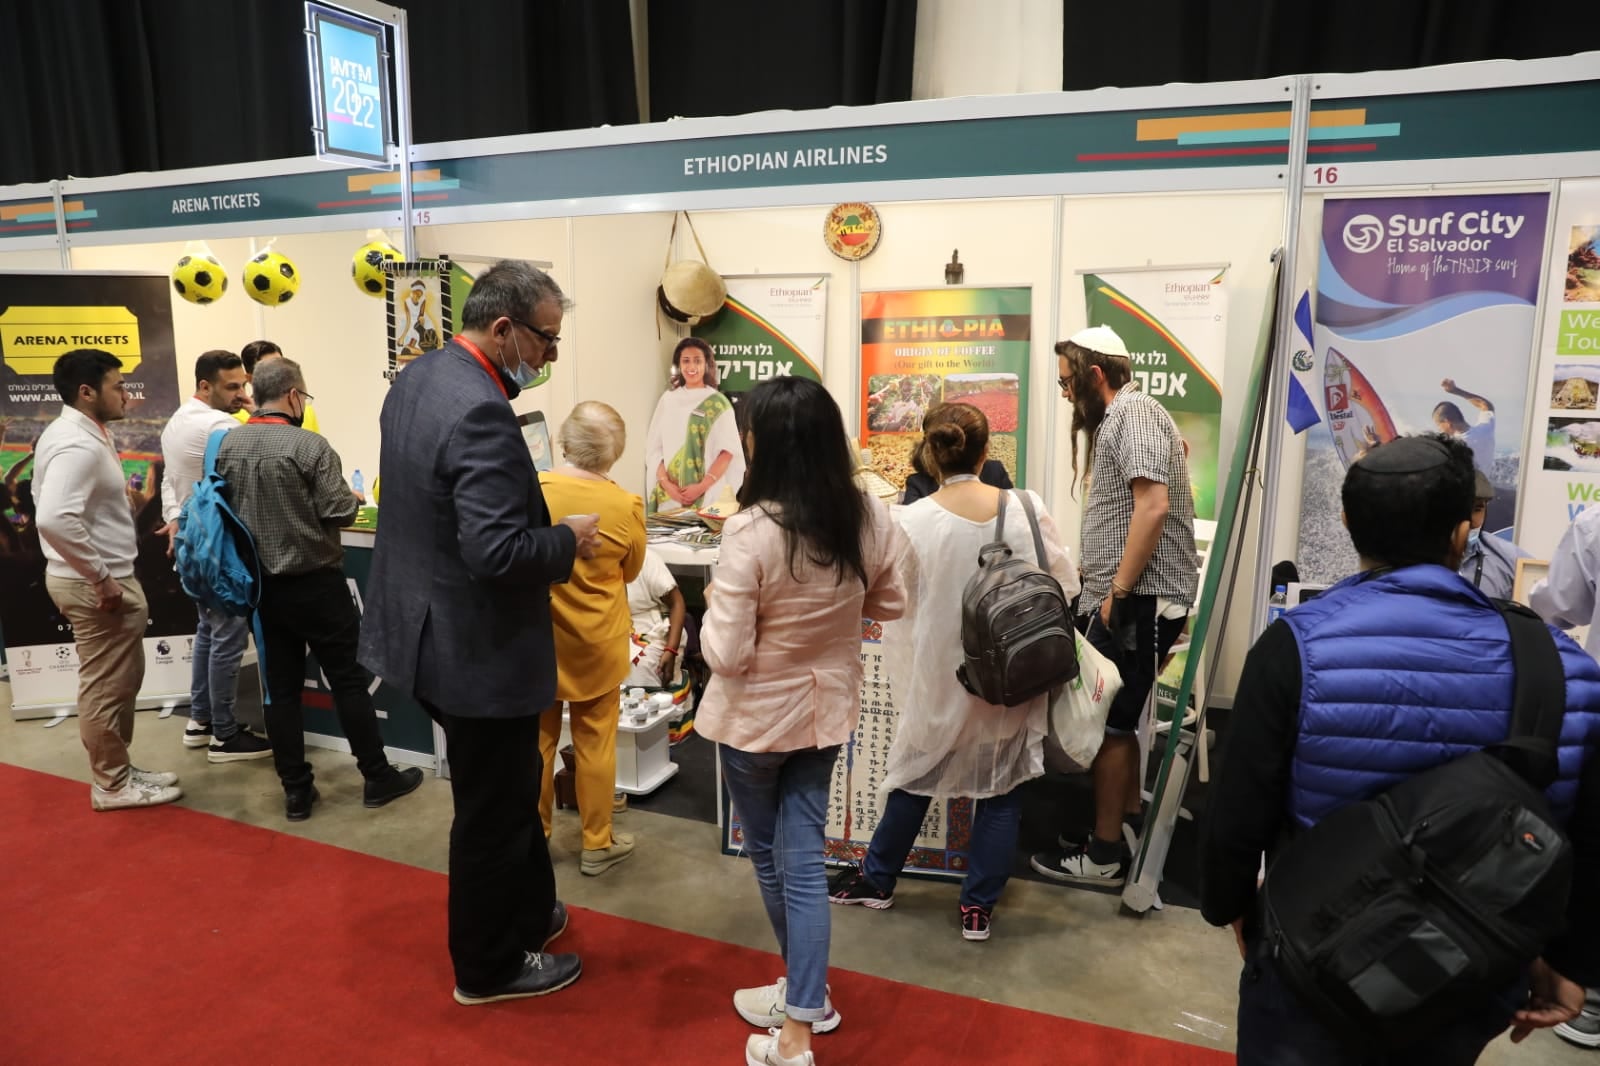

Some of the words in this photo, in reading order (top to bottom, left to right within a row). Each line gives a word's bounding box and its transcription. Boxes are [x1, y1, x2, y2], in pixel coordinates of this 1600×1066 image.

[684, 150, 788, 175] ETHIOPIAN
[793, 144, 888, 168] AIRLINES
[1313, 166, 1338, 185] 16
[171, 197, 210, 214] ARENA
[211, 192, 261, 211] TICKETS
[416, 211, 431, 224] 15
[1388, 211, 1455, 237] Surf
[1458, 209, 1525, 239] City
[1386, 237, 1405, 253] El
[1407, 236, 1492, 253] Salvador
[1387, 256, 1418, 275] Home
[1420, 261, 1430, 281] of
[1567, 313, 1600, 329] We
[14, 335, 68, 346] ARENA
[71, 335, 129, 345] TICKETS
[1564, 332, 1600, 350] Tou
[719, 344, 753, 356] איתנו
[754, 343, 774, 356] גלו
[895, 347, 933, 357] ORIGIN
[954, 345, 996, 356] COFFEE
[1147, 350, 1168, 366] גלו
[947, 358, 961, 368] the
[715, 360, 793, 385] אפריק
[1567, 482, 1600, 502] We
